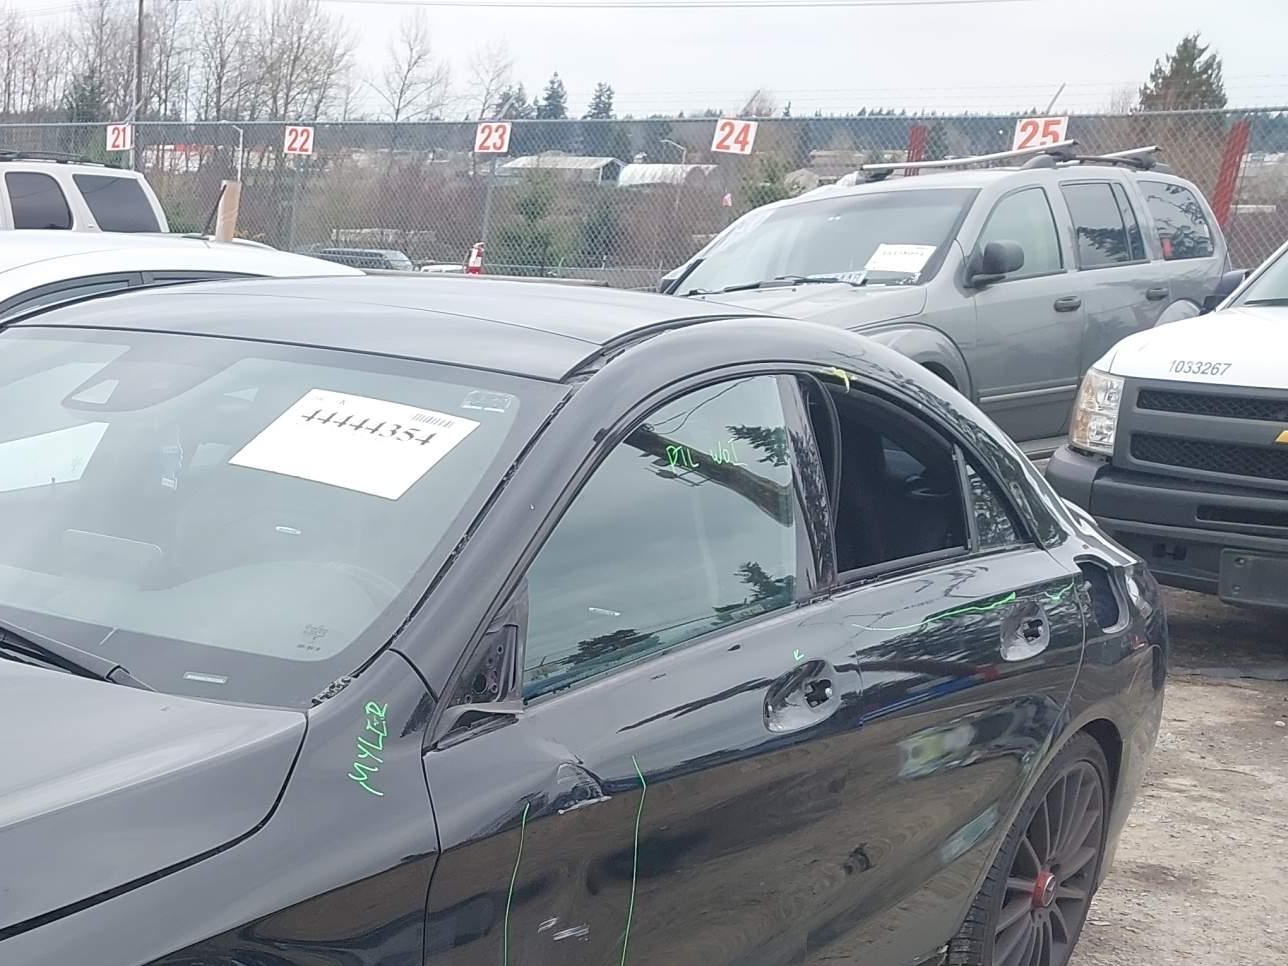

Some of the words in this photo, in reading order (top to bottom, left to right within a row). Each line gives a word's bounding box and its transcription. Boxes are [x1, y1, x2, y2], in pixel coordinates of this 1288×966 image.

[110, 126, 128, 149] 21
[286, 127, 312, 153] 22
[476, 123, 508, 151] 23
[716, 120, 751, 152] 24
[1018, 118, 1062, 150] 25
[1168, 360, 1232, 377] 1033267
[300, 408, 438, 446] 44444354
